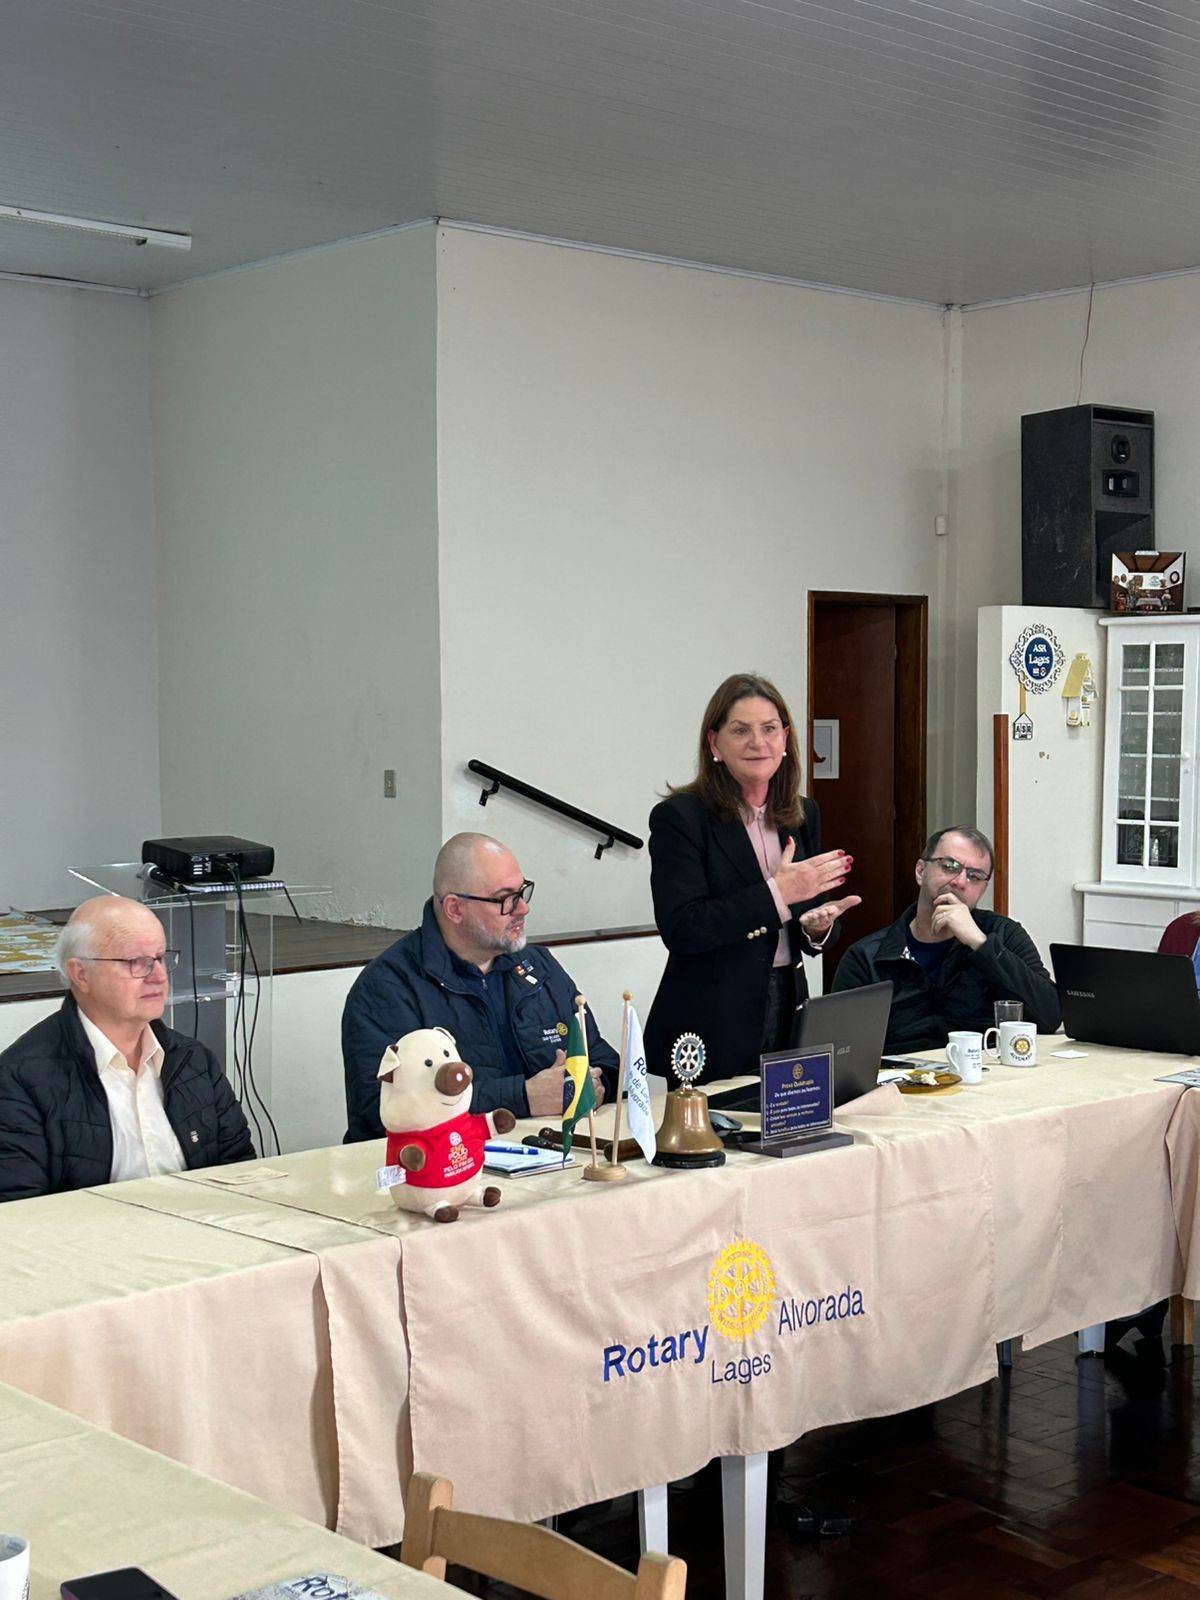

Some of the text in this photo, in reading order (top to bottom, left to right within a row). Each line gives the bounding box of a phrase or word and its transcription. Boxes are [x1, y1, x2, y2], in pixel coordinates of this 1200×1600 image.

[1029, 654, 1050, 667] Lages
[1033, 644, 1047, 653] ASR
[778, 1285, 865, 1336] Alvorada
[603, 1324, 709, 1382] Rotary
[711, 1353, 772, 1385] Lages
